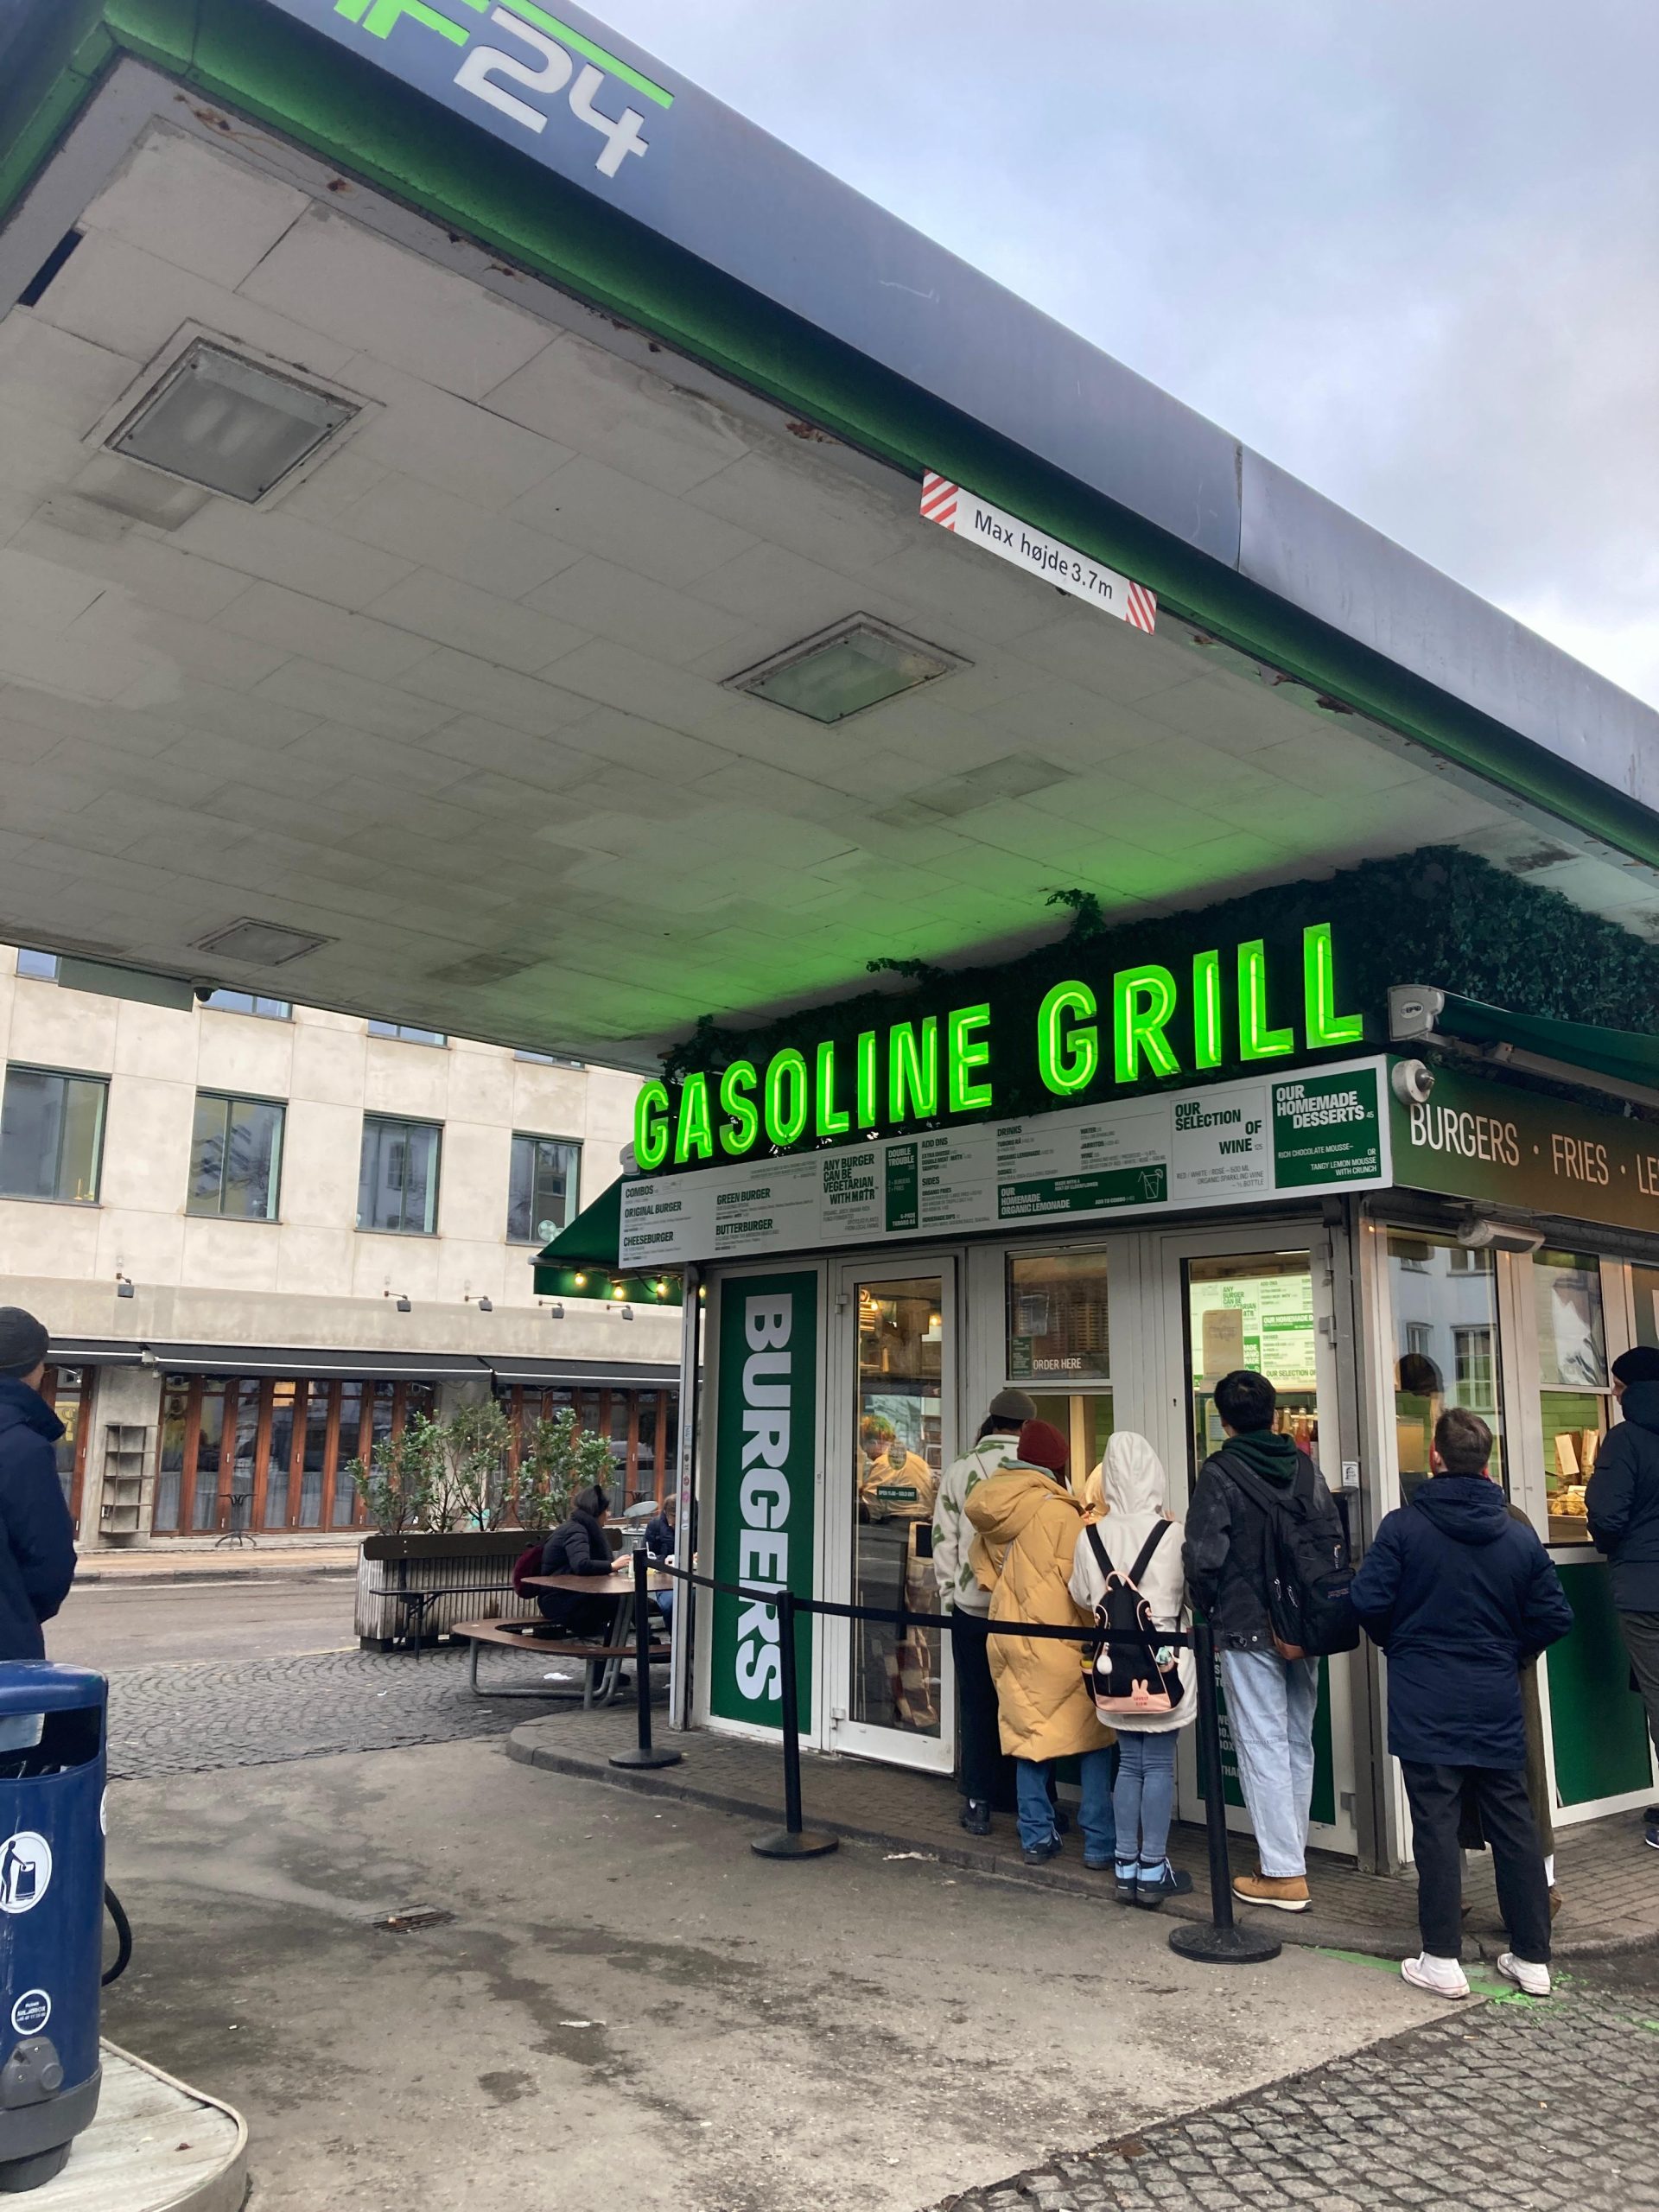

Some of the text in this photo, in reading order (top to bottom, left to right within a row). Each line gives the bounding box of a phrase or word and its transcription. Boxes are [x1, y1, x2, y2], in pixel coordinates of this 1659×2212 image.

[975, 509, 1013, 546] Max
[1020, 532, 1068, 575] højde
[633, 923, 1363, 1170] GASOLINE GRILL
[1276, 1084, 1305, 1102] OUR
[1175, 1102, 1200, 1117] OUR
[1277, 1090, 1357, 1116] HOMEMADE
[1175, 1109, 1241, 1131] SELECTION
[1293, 1105, 1364, 1128] DESSERTS
[997, 1125, 1021, 1136] DRINKS
[1245, 1120, 1262, 1135] OF
[922, 1137, 948, 1148] ADD ONS
[1219, 1138, 1252, 1154] WINE
[1410, 1103, 1659, 1196] BURGERS FRIES LE
[888, 1147, 911, 1158] DOUBLE
[1292, 1147, 1325, 1157] CHOCOLATE
[823, 1160, 839, 1172] ANY
[841, 1154, 874, 1167] BURGER
[888, 1155, 914, 1166] TROUBLE
[1310, 1156, 1376, 1171] TANGY LEMON MOUSSE
[823, 1171, 840, 1182] CAN
[842, 1168, 852, 1179] BE
[1352, 1165, 1376, 1174] CRUNCH
[823, 1176, 874, 1192] VEGETARIAN
[922, 1176, 940, 1185] SIDES
[626, 1185, 653, 1198] COMBOS
[717, 1188, 771, 1205] GREEN BURGER
[830, 1192, 852, 1205] WITH
[1001, 1187, 1015, 1197] OUR
[1001, 1193, 1041, 1206] HOMEMADE
[1001, 1199, 1071, 1215] ORGANIC LEMONADE
[625, 1201, 682, 1217] ORIGINAL BURGER
[716, 1218, 772, 1235] BUTTERBURGER
[624, 1231, 673, 1247] CHEESEBURGER
[1033, 1357, 1082, 1370] ORDER HERE
[735, 1293, 792, 1700] BURGERS
